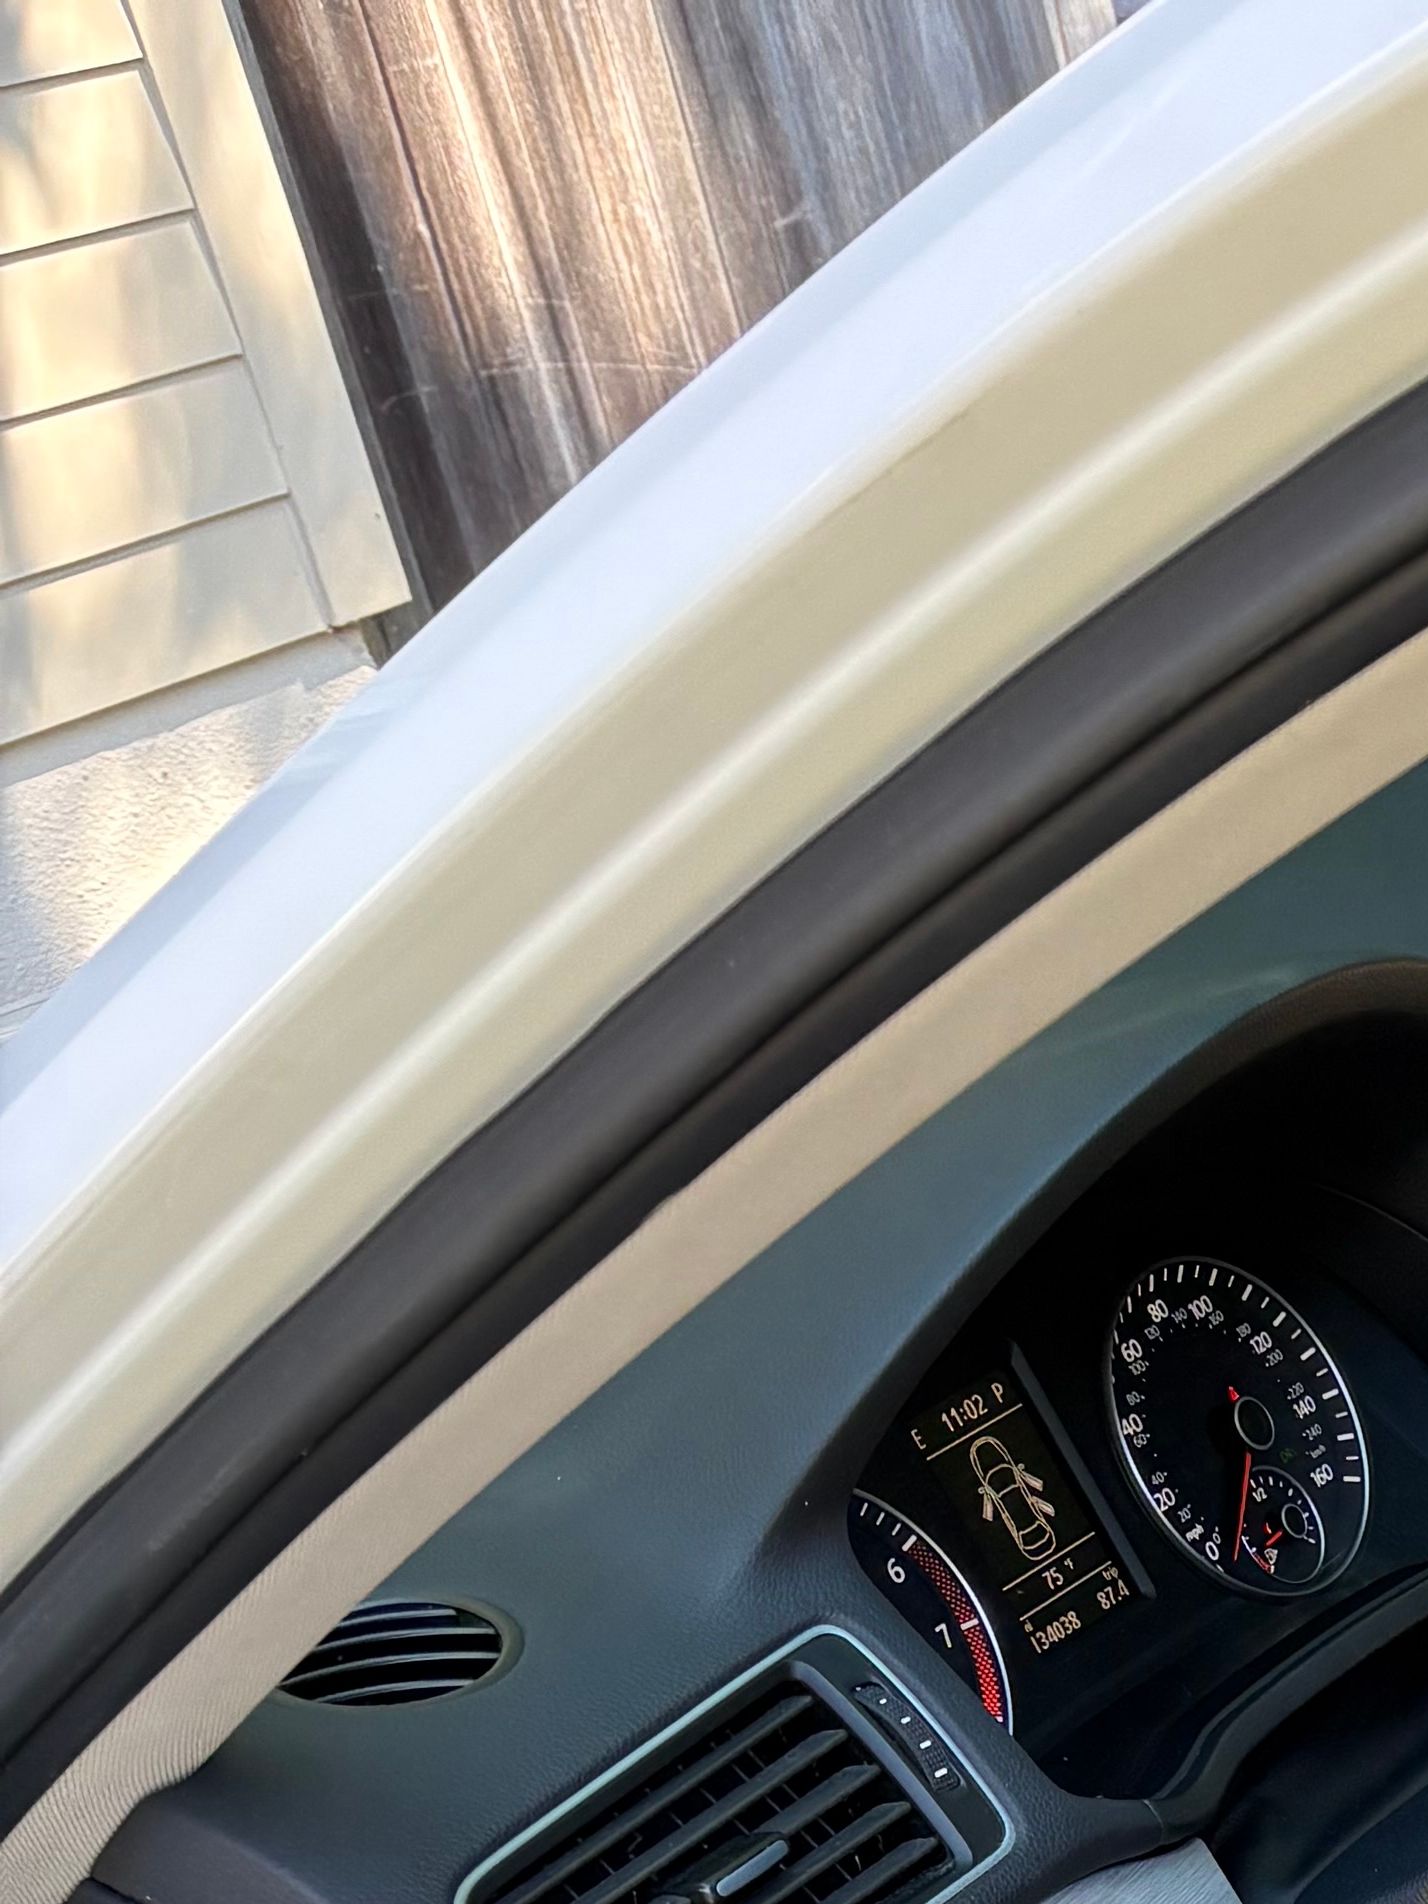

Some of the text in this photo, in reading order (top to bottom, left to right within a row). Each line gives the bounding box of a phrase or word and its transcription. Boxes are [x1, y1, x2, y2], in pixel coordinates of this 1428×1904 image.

[1147, 1299, 1168, 1323] 80
[1188, 1295, 1213, 1320] 100
[1121, 1339, 1142, 1362] 60
[1249, 1331, 1272, 1355] 120
[910, 1383, 1004, 1450] E 11:02 P
[1293, 1395, 1316, 1419] 140
[1122, 1413, 1143, 1436] 40
[1310, 1463, 1334, 1487] 160
[1153, 1487, 1176, 1511] 20
[1205, 1541, 1220, 1561] 0
[887, 1557, 906, 1584] 6
[1042, 1567, 1064, 1590] 75
[1096, 1580, 1130, 1609] 87.4
[934, 1623, 952, 1648] 7
[1030, 1611, 1082, 1653] 134038
